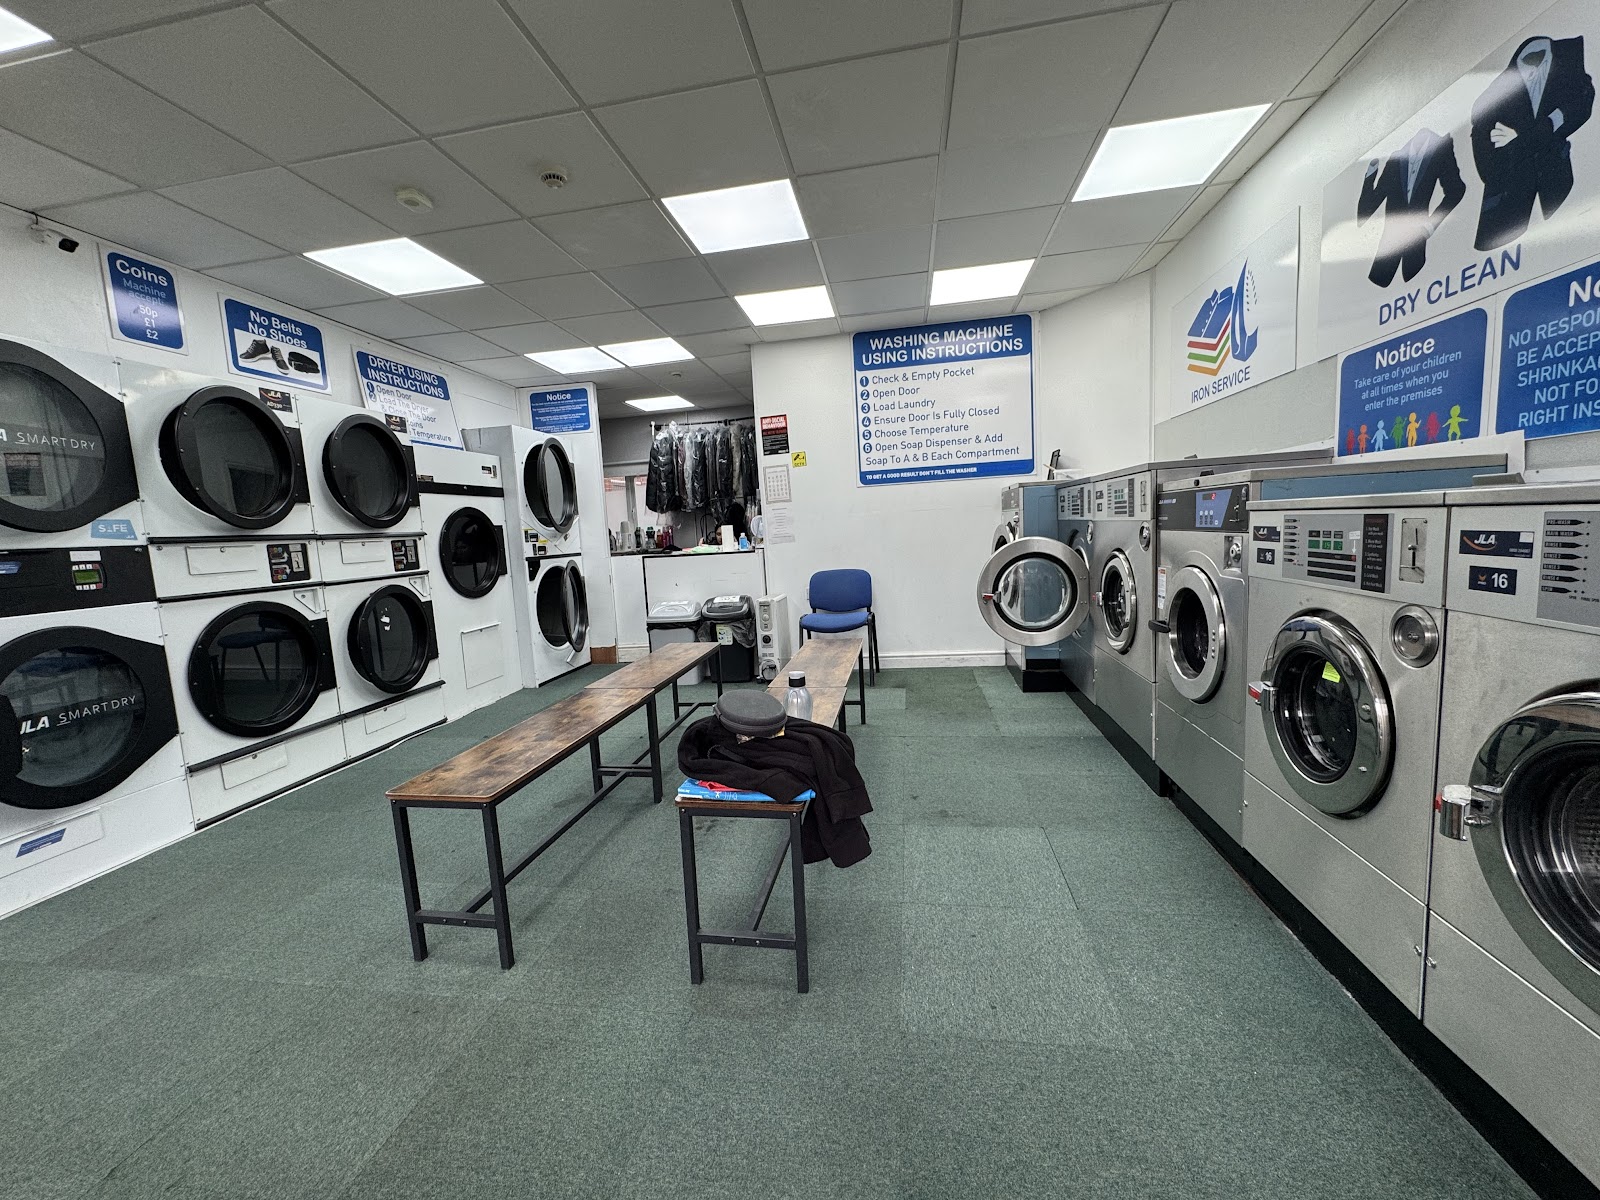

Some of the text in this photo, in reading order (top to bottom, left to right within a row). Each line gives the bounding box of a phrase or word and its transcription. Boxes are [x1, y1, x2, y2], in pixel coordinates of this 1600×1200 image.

[116, 259, 168, 286] Coins
[123, 278, 166, 298] Machine
[1379, 243, 1521, 325] DRY CLEAN
[139, 304, 158, 318] 50p
[144, 317, 155, 328] £1
[250, 309, 302, 336] No Belts
[146, 329, 158, 340] £2
[248, 321, 308, 349] No Shoes
[869, 324, 1014, 350] WASHING MACHINE
[1508, 329, 1531, 349] NO
[862, 338, 1023, 366] USING INSTRUCTIONS
[1375, 337, 1435, 370] Notice
[1516, 347, 1538, 367] BE
[368, 355, 438, 385] DRYER USING
[872, 374, 899, 385] Check
[901, 373, 909, 382] &
[911, 370, 940, 381] Empty
[943, 367, 974, 378] Pocket
[1354, 350, 1462, 390] Take care of your children
[1517, 355, 1600, 387] SHRINKA
[367, 367, 444, 398] INSTRUCTIONS
[376, 385, 394, 396] Open
[396, 389, 412, 400] Door
[1191, 365, 1250, 404] IRON SERVICE
[1361, 369, 1449, 400] at all times when you
[546, 393, 571, 401] Notice
[872, 388, 896, 400] Open
[898, 386, 920, 396] Door
[1364, 386, 1442, 411] enter the premises
[1534, 382, 1570, 405] NOT
[379, 395, 396, 406] Load
[398, 399, 410, 409] The
[412, 403, 429, 414] Dryer
[409, 409, 421, 419] The
[873, 402, 896, 412] Load
[898, 399, 936, 411] Laundry
[874, 414, 906, 425] Ensure
[908, 412, 930, 422] Door
[932, 411, 940, 420] Is
[943, 408, 966, 420] Fully
[968, 406, 1000, 417] Closed
[1518, 404, 1569, 428] RIGHT
[412, 427, 452, 442] Temperature
[874, 428, 907, 438] Choose
[909, 423, 969, 438] Temperature
[875, 443, 898, 454] Open
[900, 440, 922, 451] Soap
[925, 436, 972, 450] Dispenser
[974, 434, 982, 444] &
[984, 434, 1003, 443] Add
[865, 446, 1020, 467] Soap To A & B Each Compartment
[956, 466, 977, 474] WASHER
[1474, 533, 1496, 545] JLA
[1265, 551, 1272, 562] 16
[1491, 572, 1508, 589] 16
